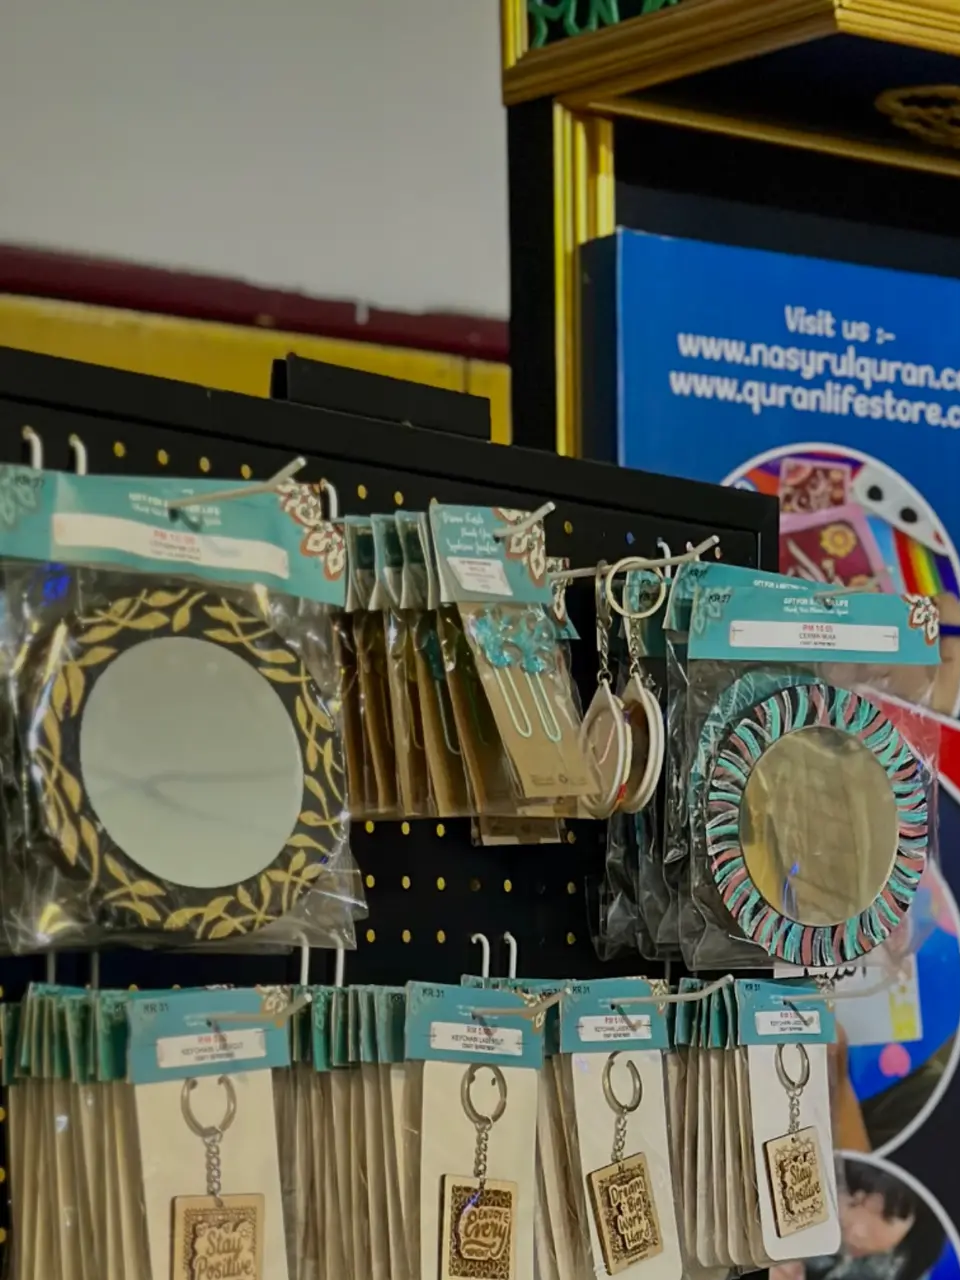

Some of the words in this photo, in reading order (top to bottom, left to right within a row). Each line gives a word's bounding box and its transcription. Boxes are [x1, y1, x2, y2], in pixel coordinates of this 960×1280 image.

[785, 305, 836, 338] Visit
[842, 317, 870, 341] us
[206, 1230, 243, 1260] Stay
